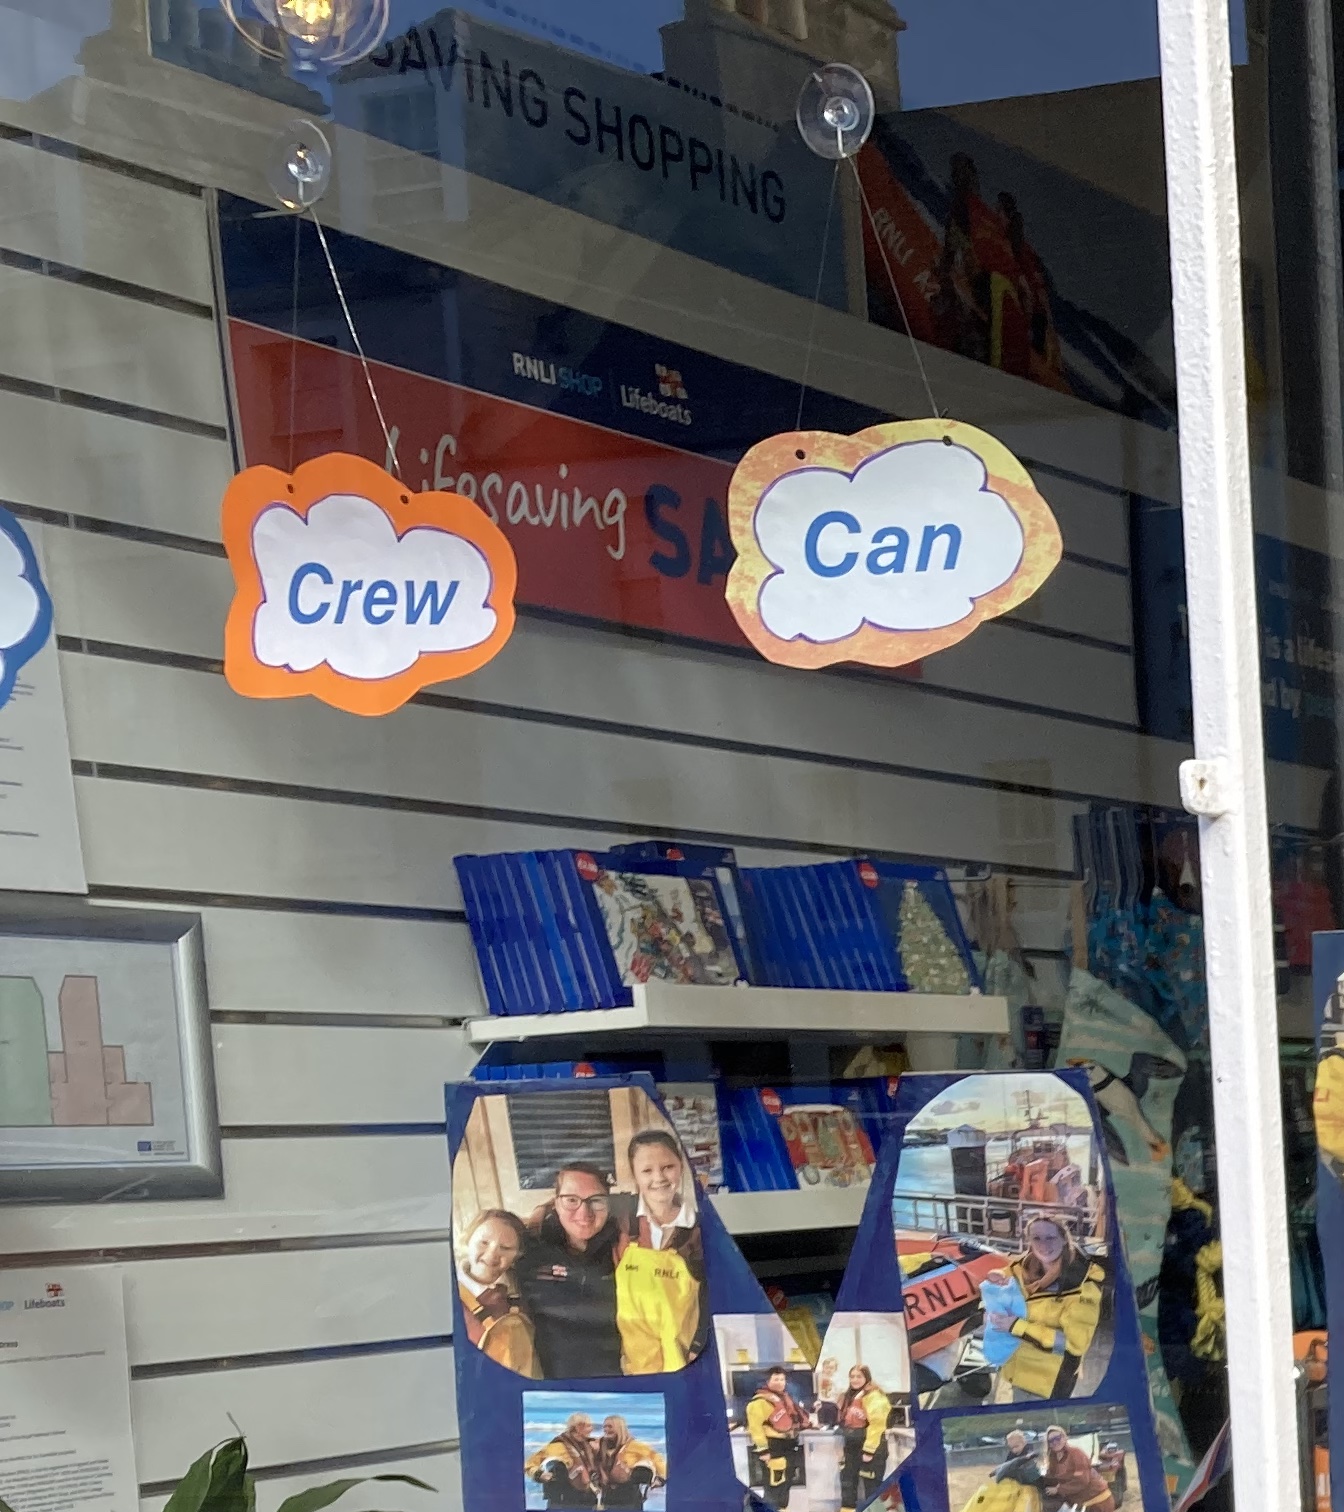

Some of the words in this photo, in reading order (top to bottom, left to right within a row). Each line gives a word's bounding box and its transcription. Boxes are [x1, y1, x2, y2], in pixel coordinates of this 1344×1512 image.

[563, 86, 786, 224] SHOPPING
[512, 351, 557, 386] RNLI
[558, 366, 603, 395] SHOP
[619, 383, 693, 426] Lifeboats
[803, 511, 963, 581] Can
[288, 562, 460, 626] Crew
[24, 1298, 66, 1311] Lifeboats
[903, 1270, 977, 1321] RNLI
